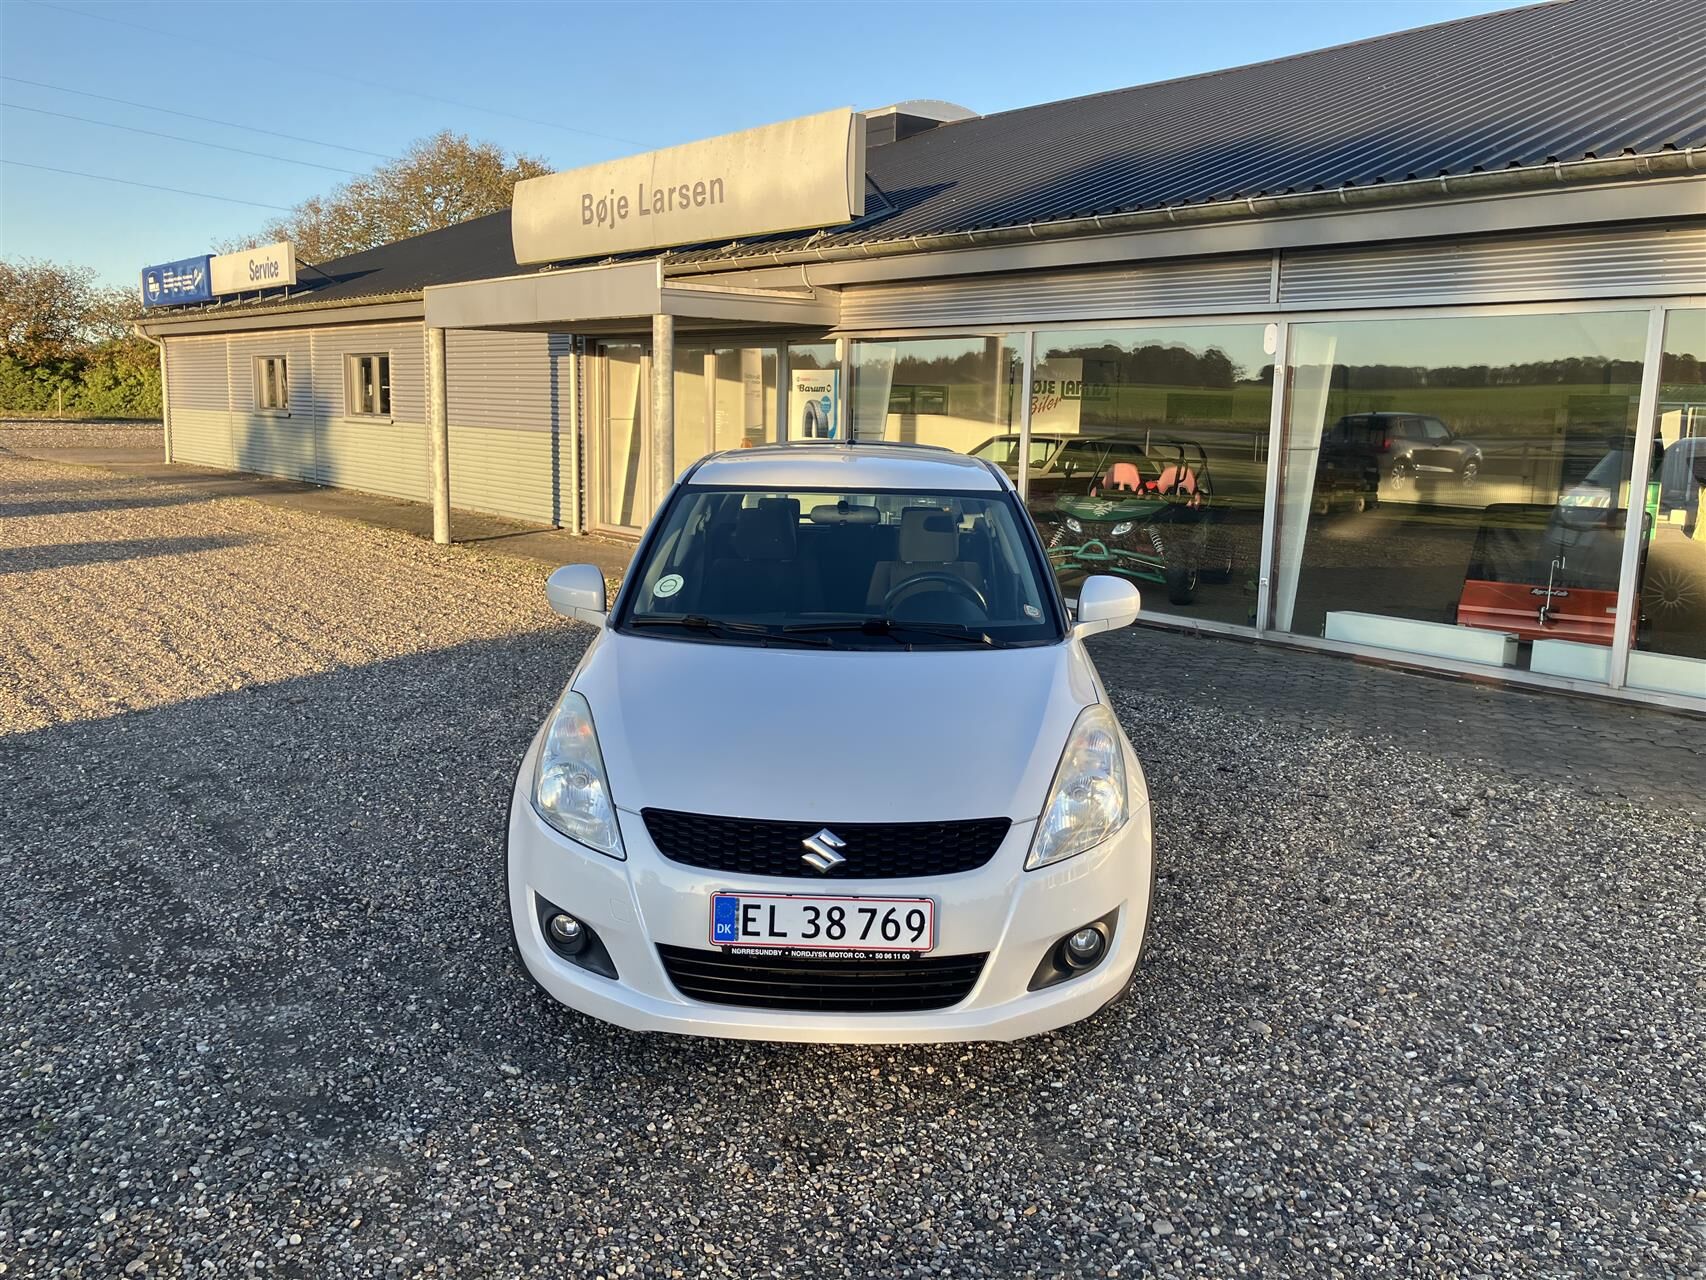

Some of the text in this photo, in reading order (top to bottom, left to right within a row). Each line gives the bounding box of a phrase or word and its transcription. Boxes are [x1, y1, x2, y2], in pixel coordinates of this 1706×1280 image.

[582, 177, 724, 230] Bøje Larsen
[249, 256, 279, 282] Service
[798, 384, 825, 393] Barum
[1032, 380, 1055, 395] ØJE
[716, 923, 732, 934] DK
[742, 904, 926, 943] EL 38 769
[791, 950, 828, 958] NORDJYSK
[828, 951, 853, 959] MOTOR
[875, 952, 883, 960] 50
[893, 952, 900, 960] 11
[902, 952, 910, 960] 00
